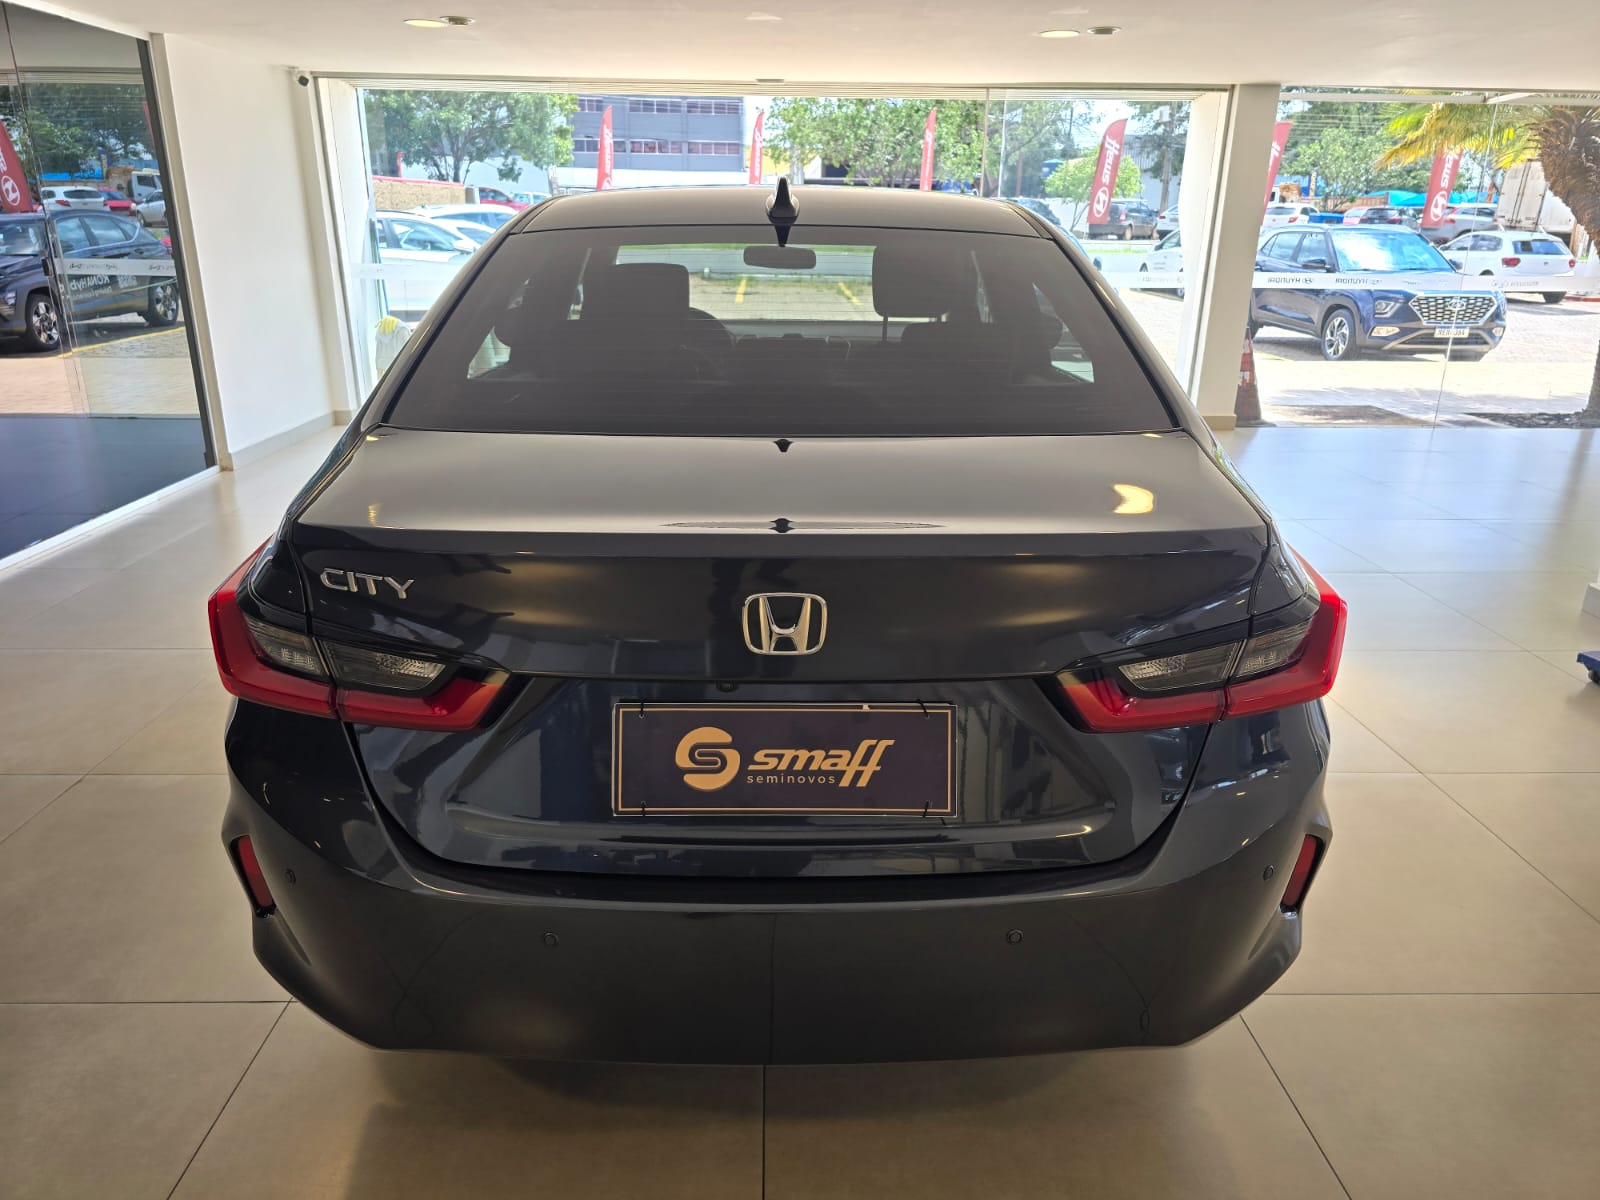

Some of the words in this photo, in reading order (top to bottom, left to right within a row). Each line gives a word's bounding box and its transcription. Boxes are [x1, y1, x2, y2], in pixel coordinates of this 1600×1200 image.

[320, 567, 415, 599] CITY
[747, 739, 896, 788] smaff
[747, 773, 836, 784] seminovos
